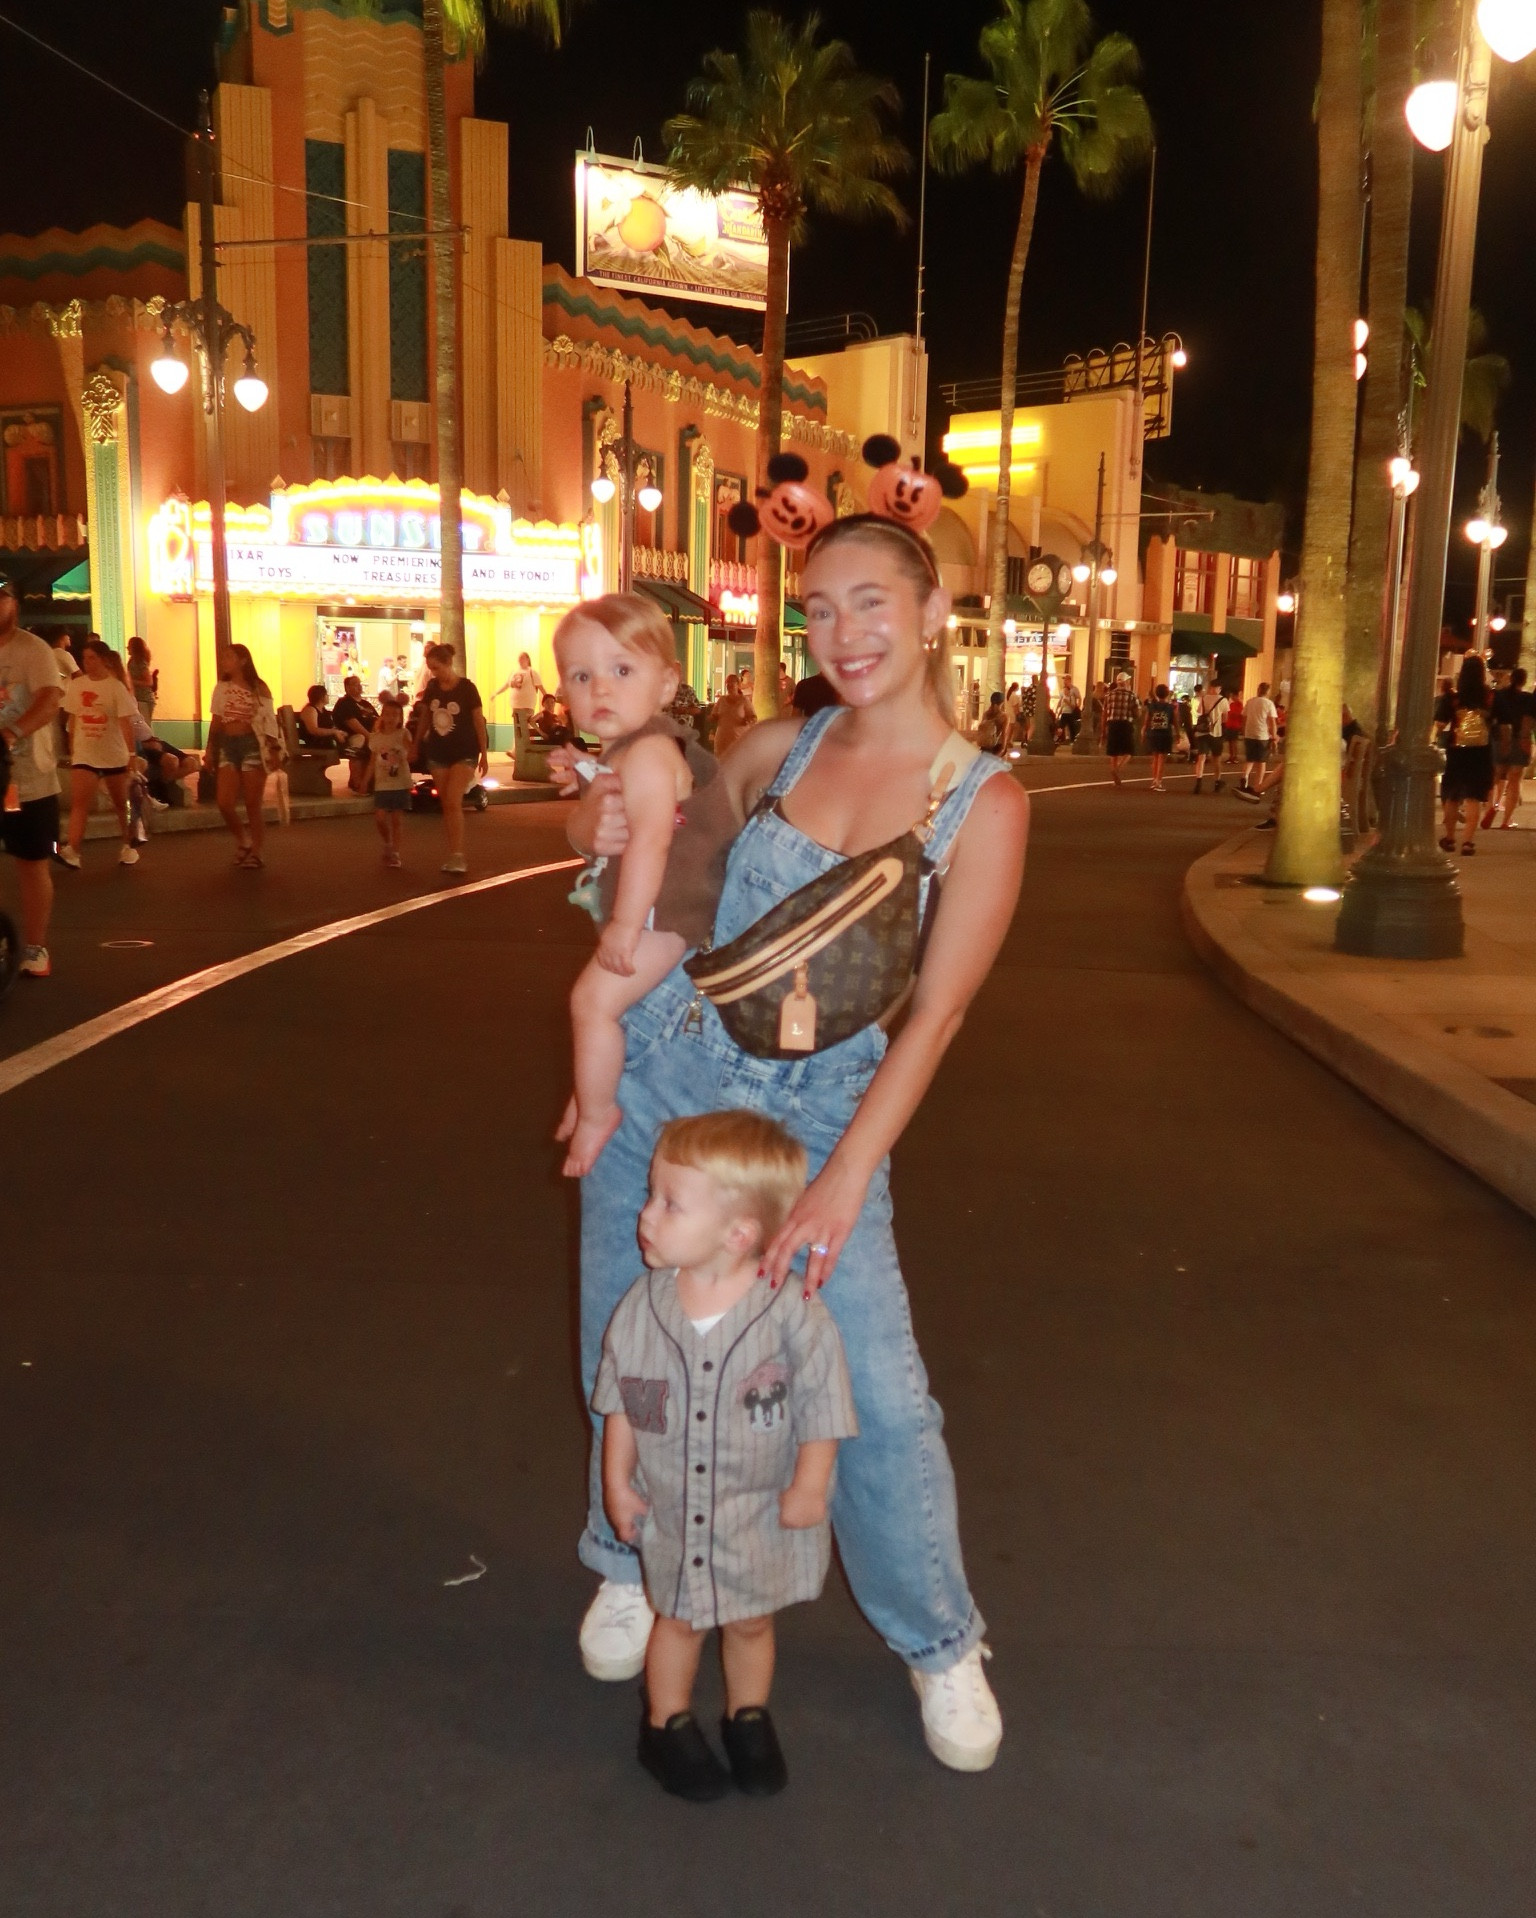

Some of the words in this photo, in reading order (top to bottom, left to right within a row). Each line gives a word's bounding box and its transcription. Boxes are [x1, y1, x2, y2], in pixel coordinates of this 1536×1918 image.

[611, 272, 631, 282] FINEST
[633, 275, 666, 287] CALIFORNIA
[667, 281, 688, 290] GROWN
[230, 549, 264, 561] IXAR
[333, 554, 359, 564] NOW
[258, 567, 292, 578] TOYS
[363, 571, 437, 583] TREASURES
[472, 568, 495, 579] AND
[503, 570, 555, 581] BEYOND!
[621, 1376, 669, 1435] M
